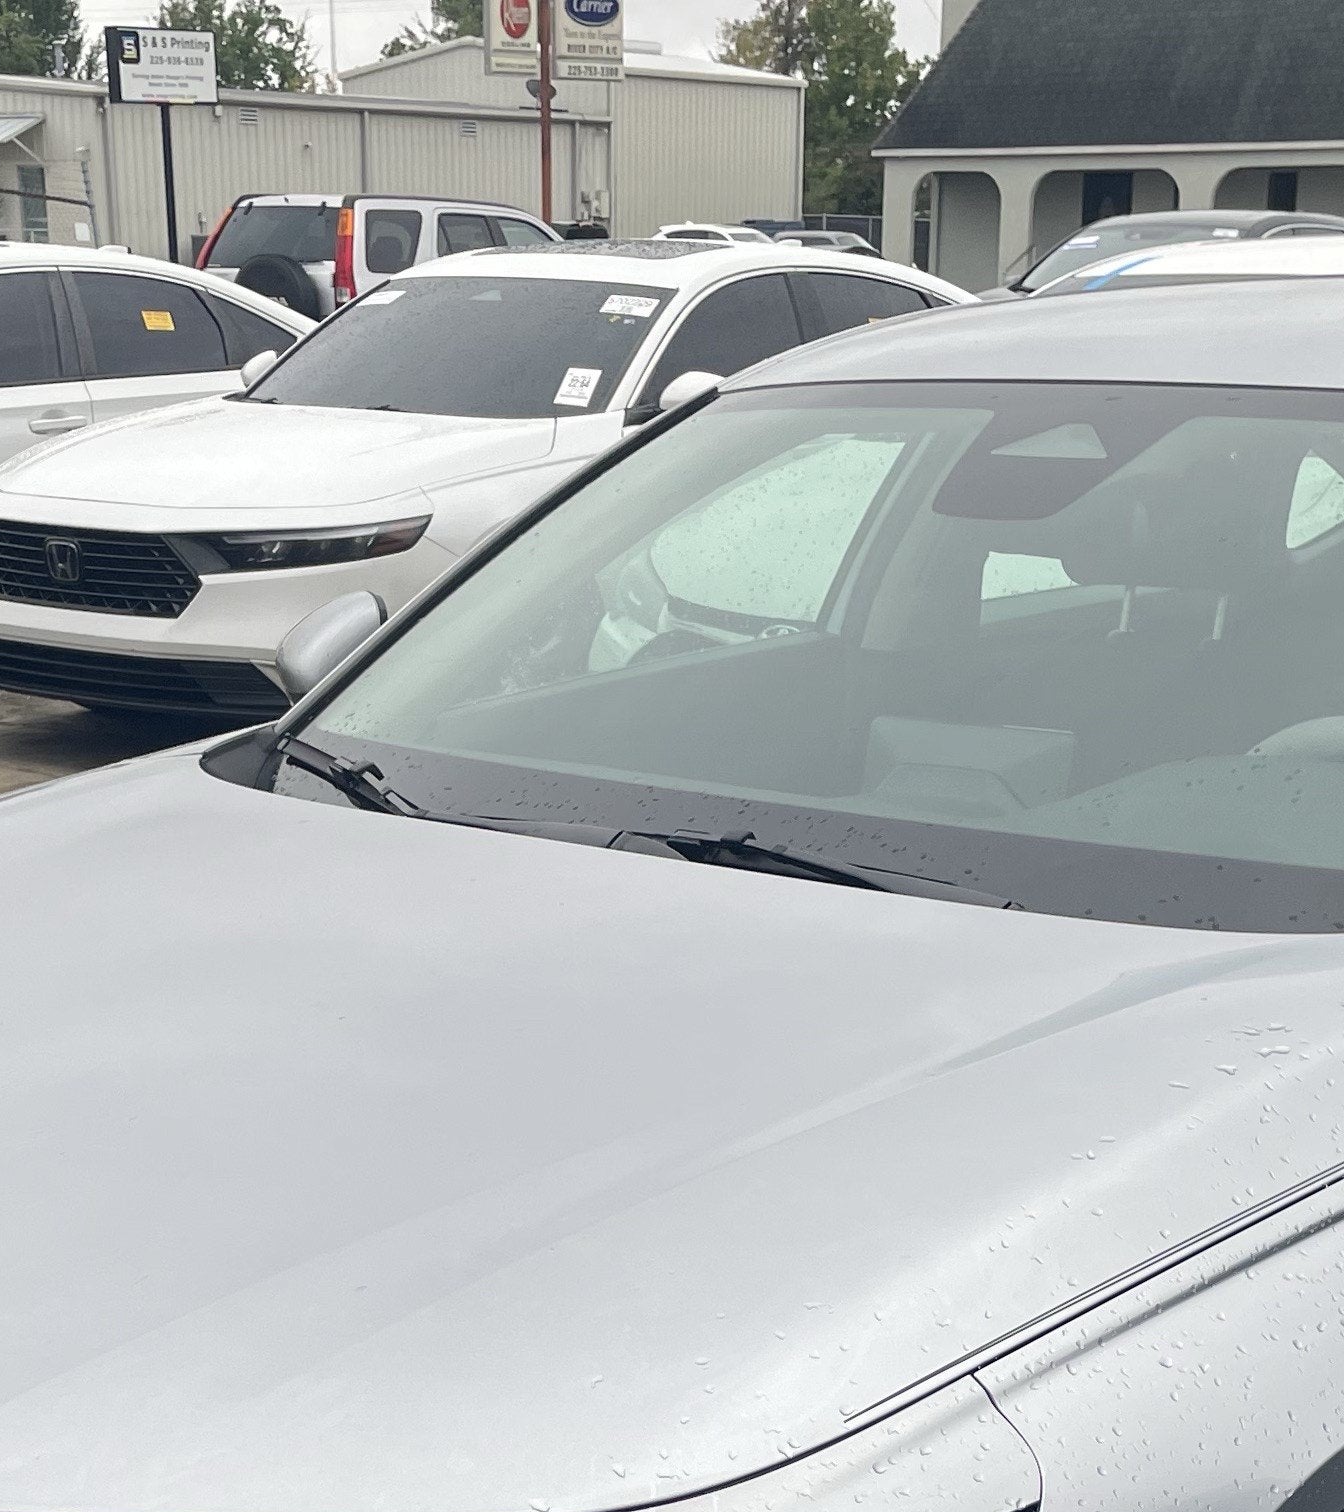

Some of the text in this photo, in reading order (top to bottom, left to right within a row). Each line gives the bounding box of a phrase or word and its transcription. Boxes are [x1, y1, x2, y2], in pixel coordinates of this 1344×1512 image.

[142, 36, 211, 52] S & S Printing
